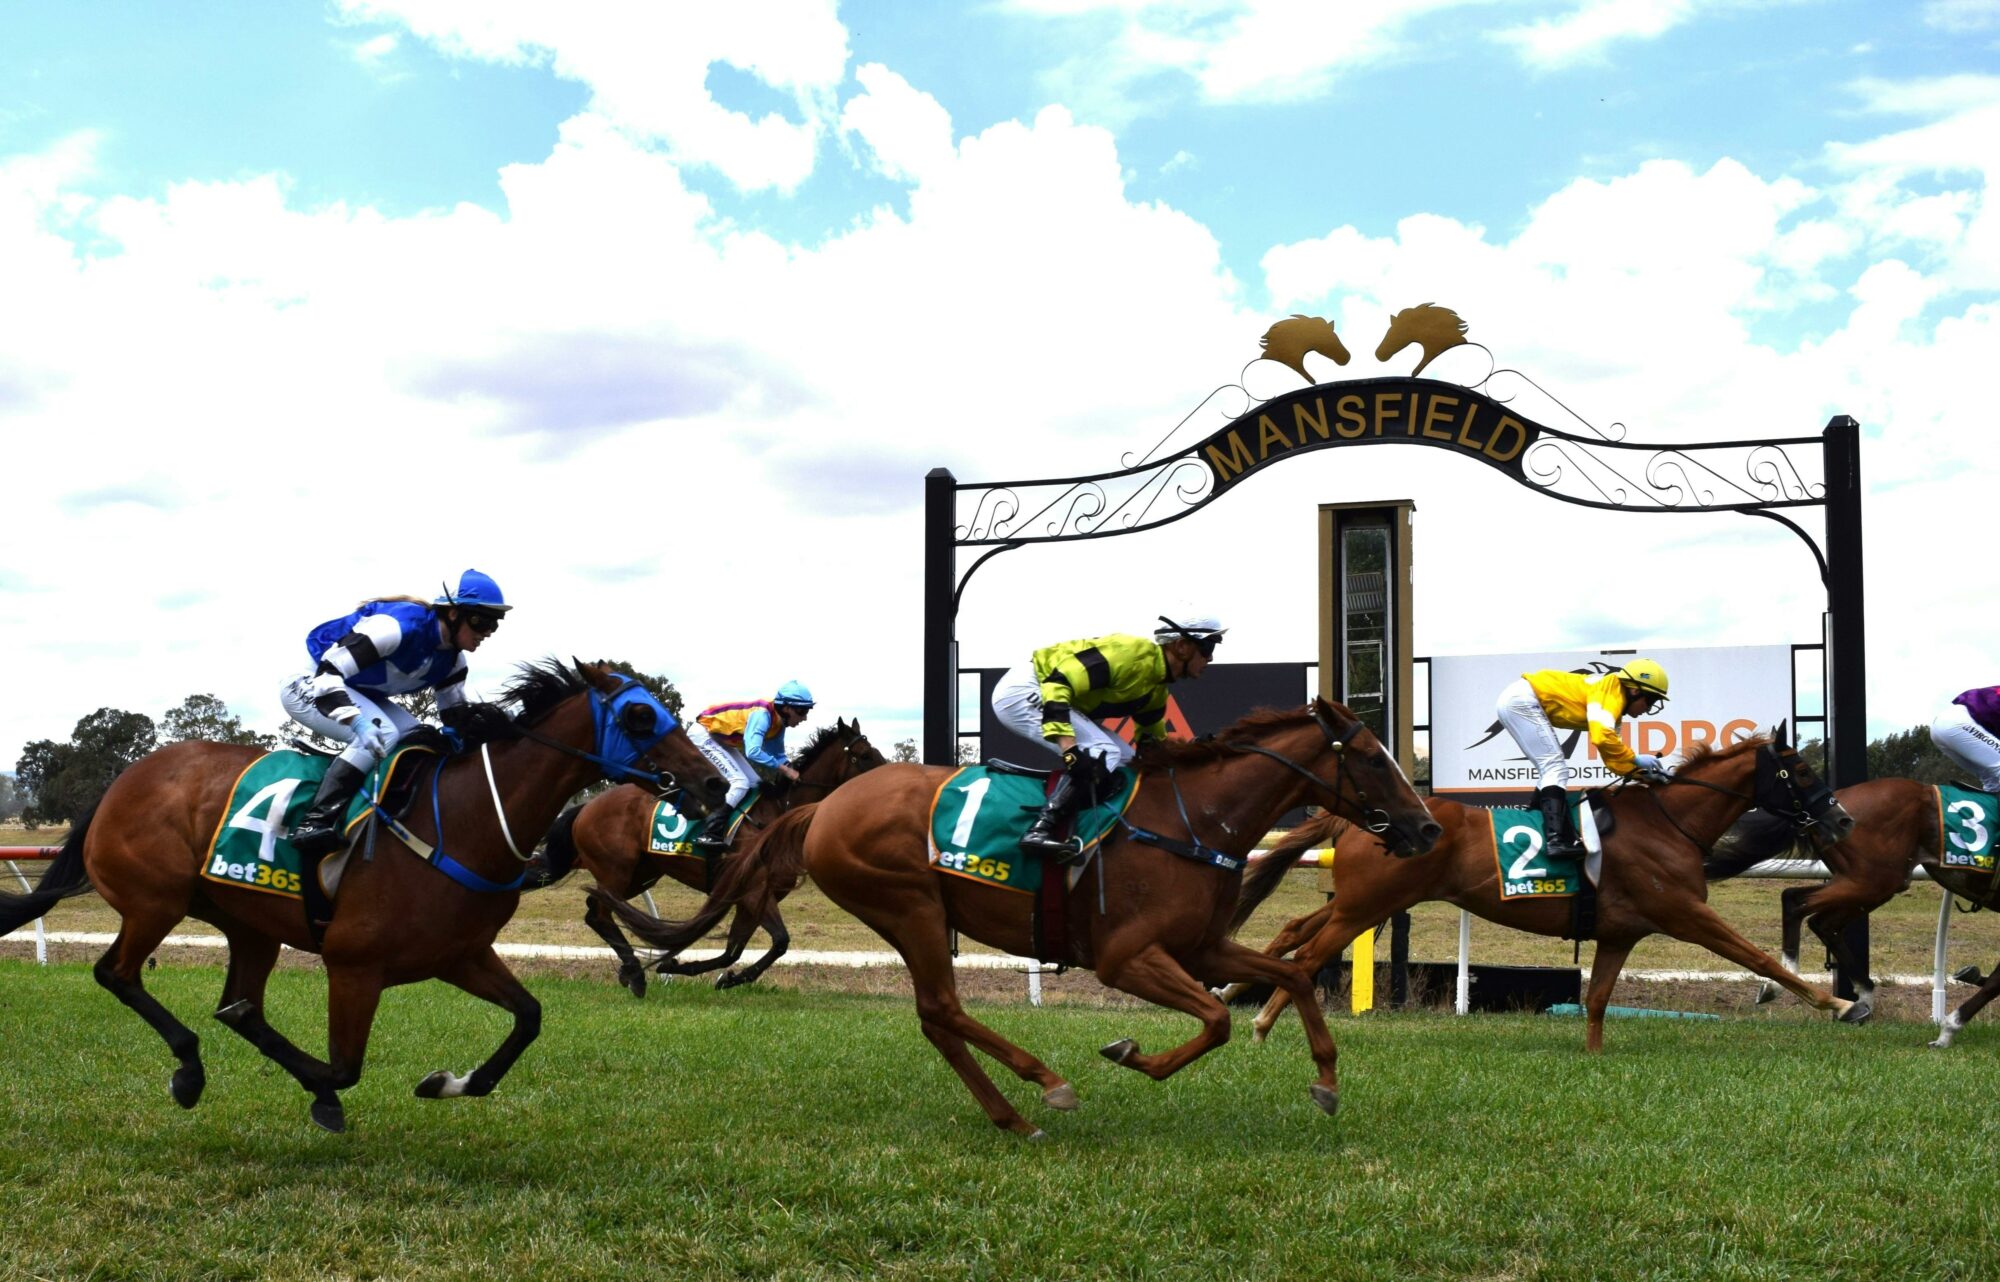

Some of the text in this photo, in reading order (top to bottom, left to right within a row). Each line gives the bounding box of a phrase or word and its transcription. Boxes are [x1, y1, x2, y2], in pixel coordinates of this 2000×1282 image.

[1205, 392, 1526, 482] MANSFIELD
[1468, 766, 1615, 780] MANSFIE DISTR
[229, 778, 302, 862] 4
[951, 777, 991, 848] 1
[1947, 800, 1988, 852] 3
[210, 854, 302, 892] bet365
[939, 851, 1011, 881] et365
[1502, 825, 1547, 879] 2
[1946, 851, 1994, 868] bet36
[1505, 879, 1566, 895] bet365
